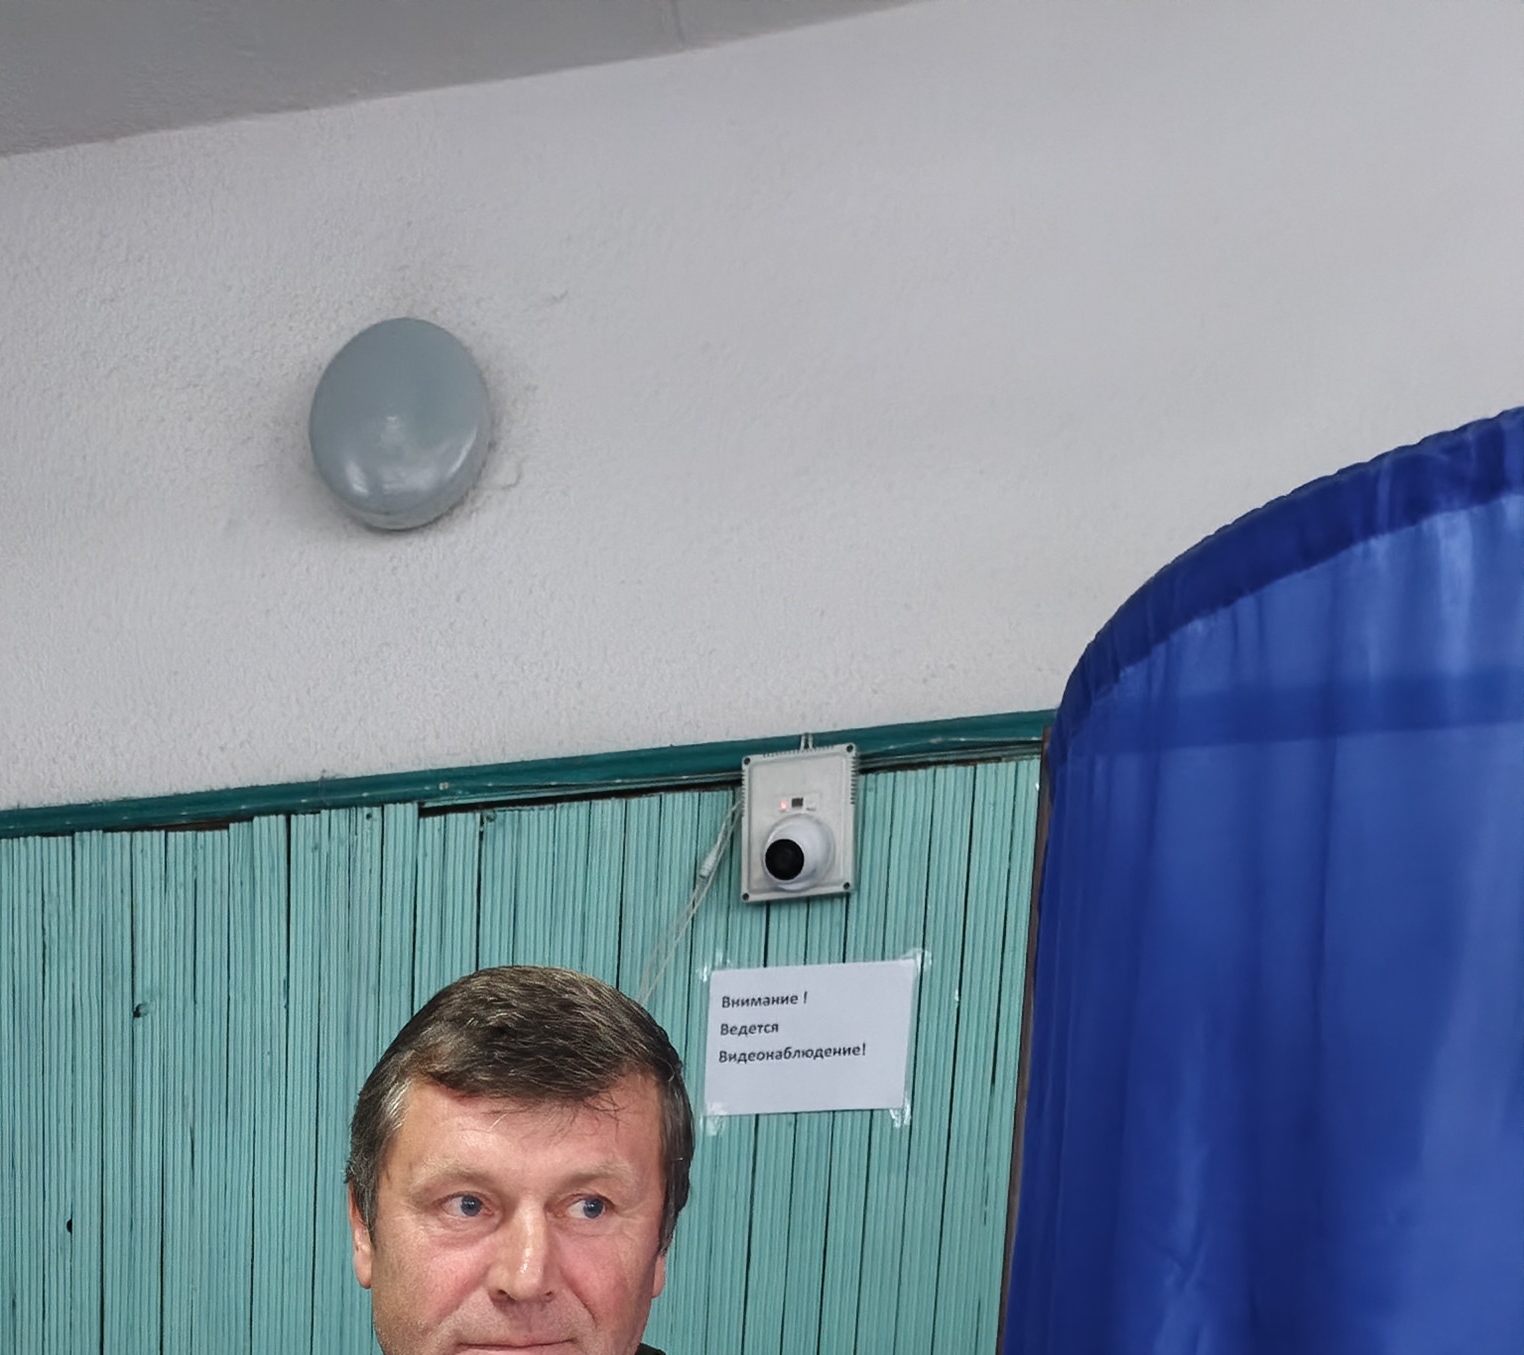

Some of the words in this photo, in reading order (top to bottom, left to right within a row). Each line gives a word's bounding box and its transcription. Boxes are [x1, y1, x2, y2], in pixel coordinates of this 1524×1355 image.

[721, 995, 799, 1009] Внимание
[720, 1022, 780, 1037] Ведется
[718, 1042, 867, 1064] Видеонаблюдение!
